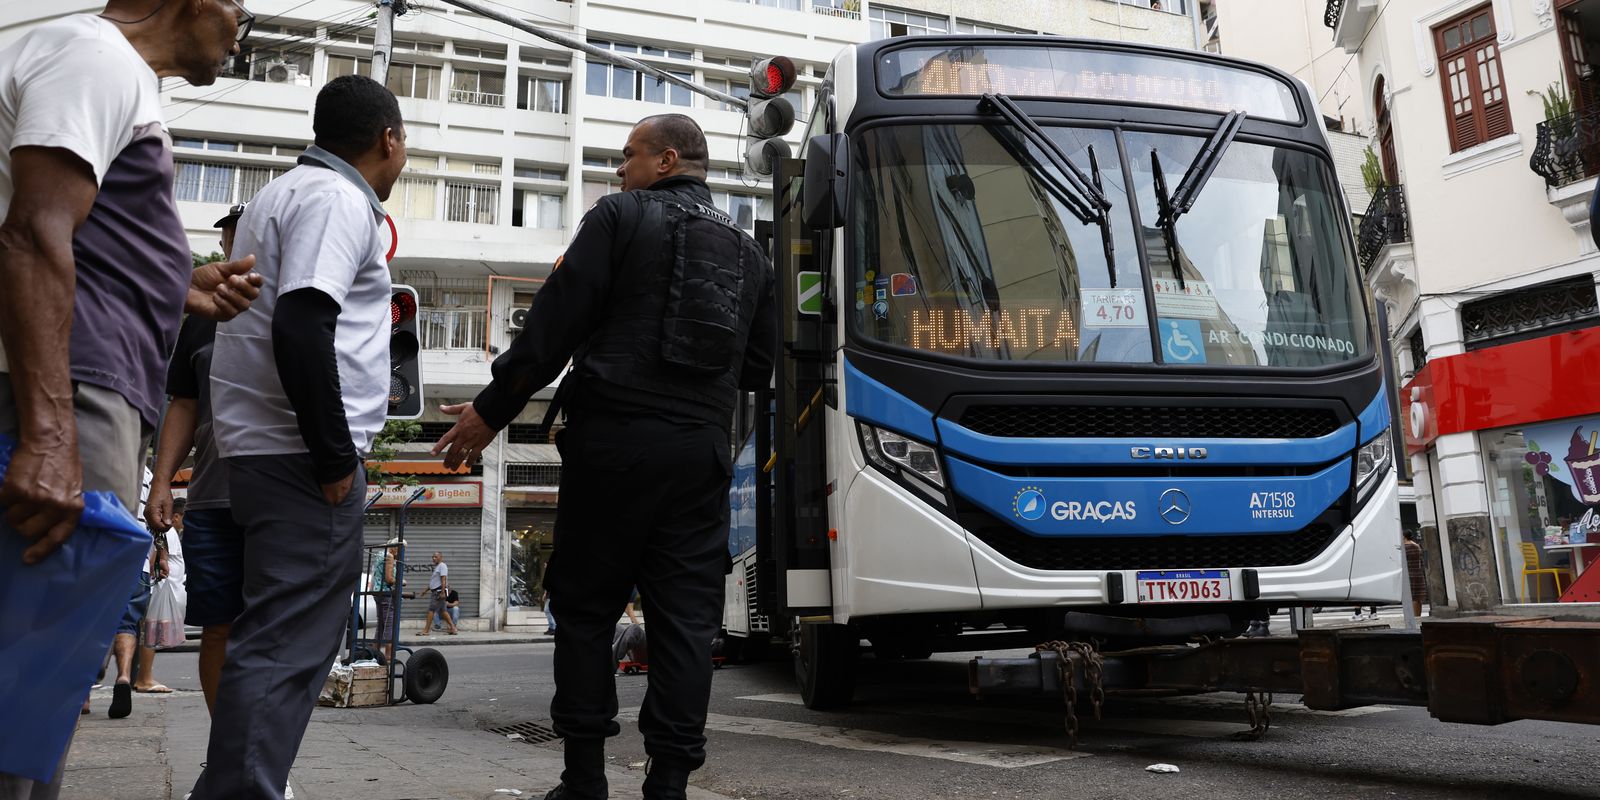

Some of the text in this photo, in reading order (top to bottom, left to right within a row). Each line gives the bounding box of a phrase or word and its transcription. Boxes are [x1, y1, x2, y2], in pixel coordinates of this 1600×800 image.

[1096, 305, 1135, 322] 4,70
[911, 308, 1079, 349] HUMAITA
[1208, 329, 1232, 344] AR
[1130, 446, 1208, 459] CAIO
[1249, 491, 1296, 508] A71518
[1051, 501, 1137, 523] GRAÇAS
[1252, 509, 1295, 519] INTERSUL
[1145, 581, 1221, 600] TTK9D63
